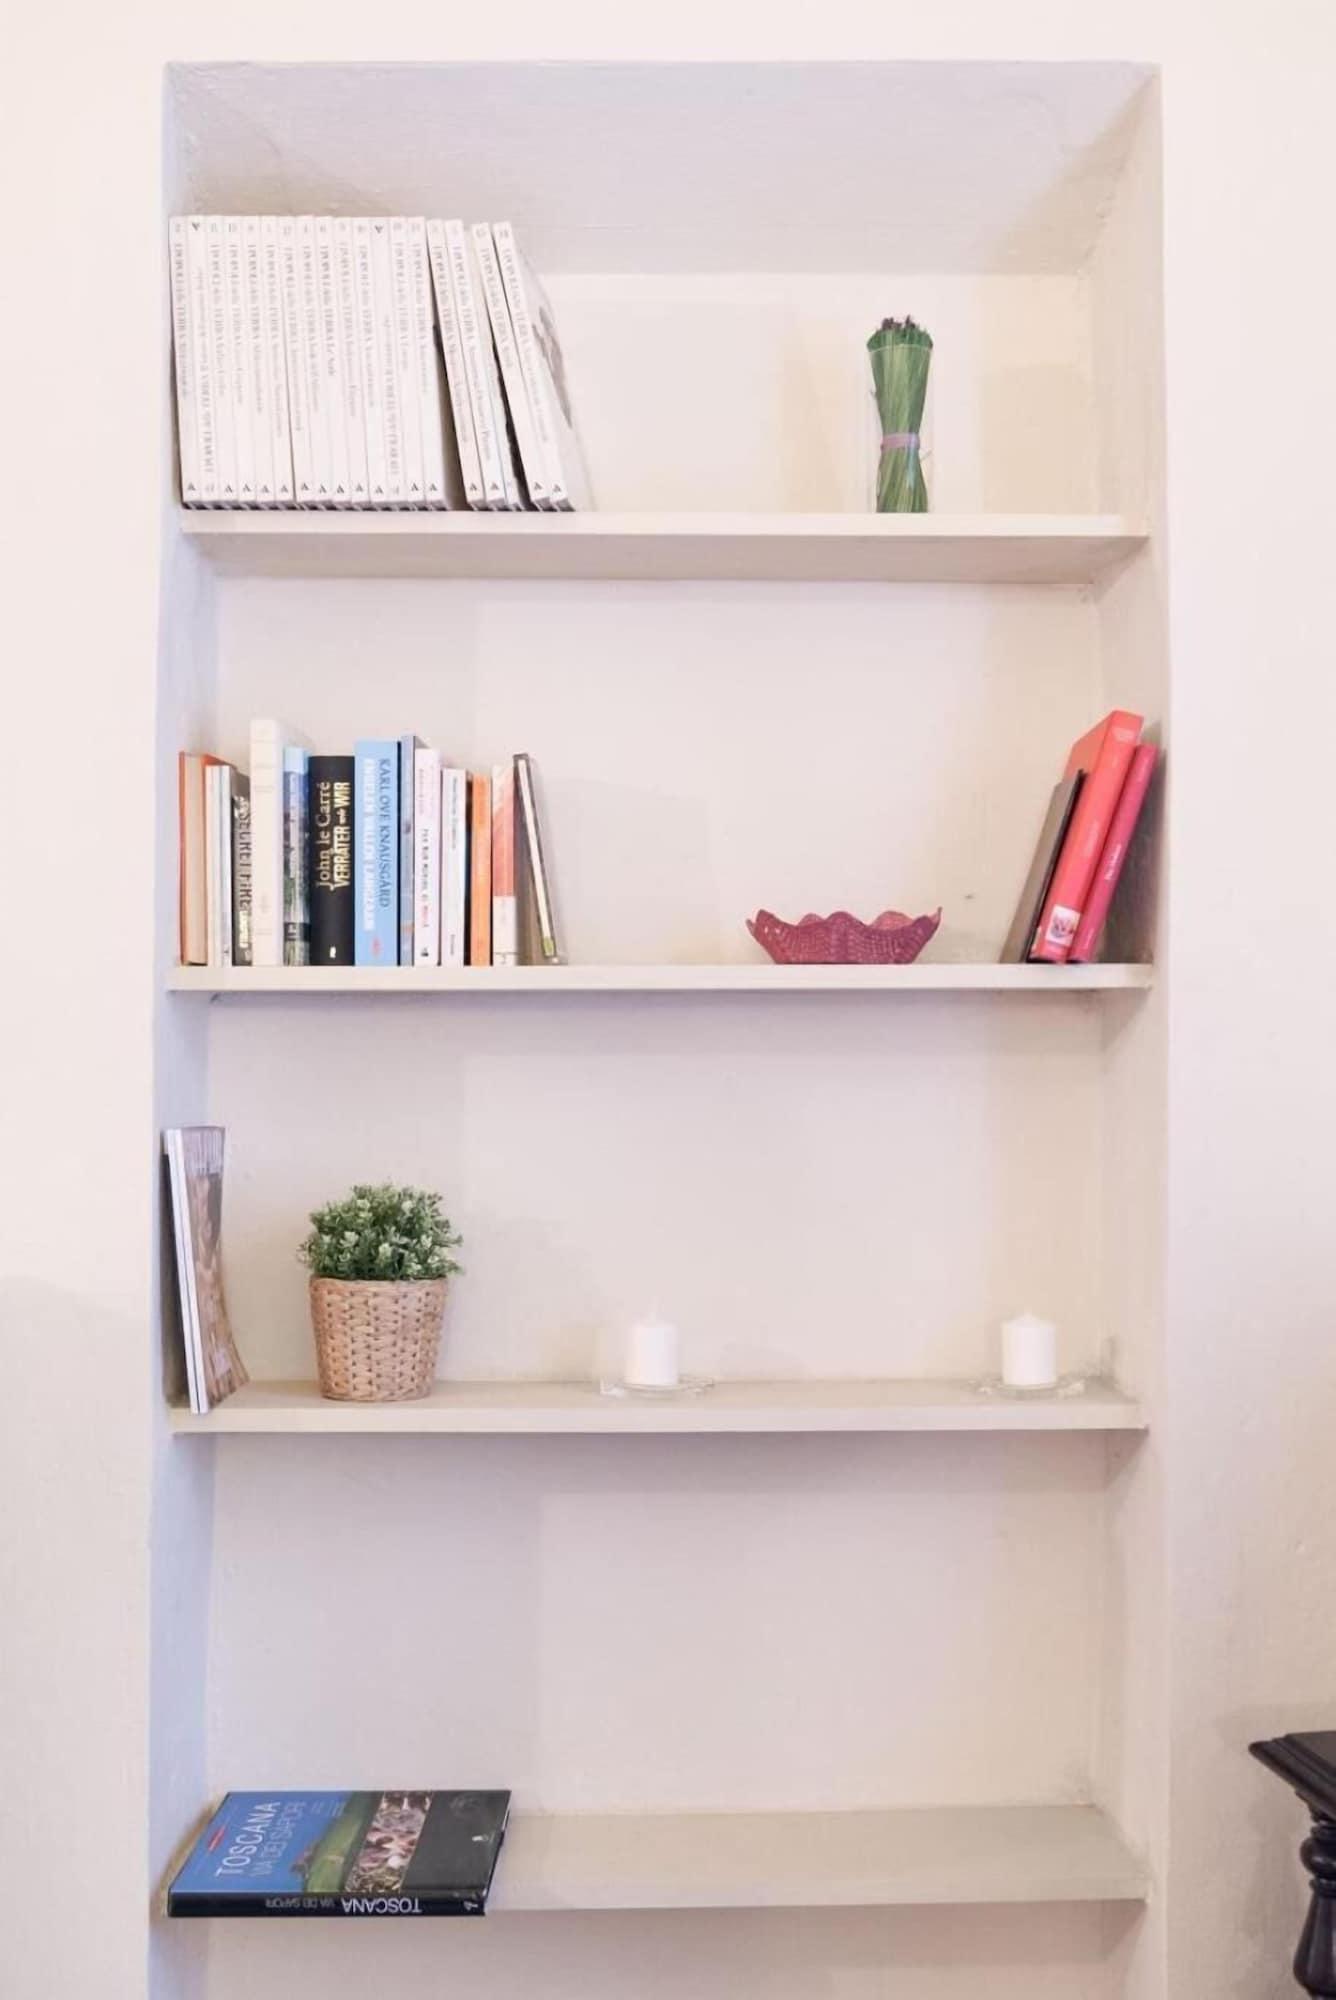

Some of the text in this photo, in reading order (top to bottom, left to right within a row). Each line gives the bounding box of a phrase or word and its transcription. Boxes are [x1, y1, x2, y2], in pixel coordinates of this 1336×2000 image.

[379, 758, 391, 791] KARL
[333, 782, 351, 807] WIR
[379, 795, 391, 824] OVE
[314, 782, 335, 892] John le Carré
[331, 826, 351, 888] VERRÄTER
[214, 1801, 281, 1878] TOSCANA
[341, 1896, 422, 1914] TOSCANA
